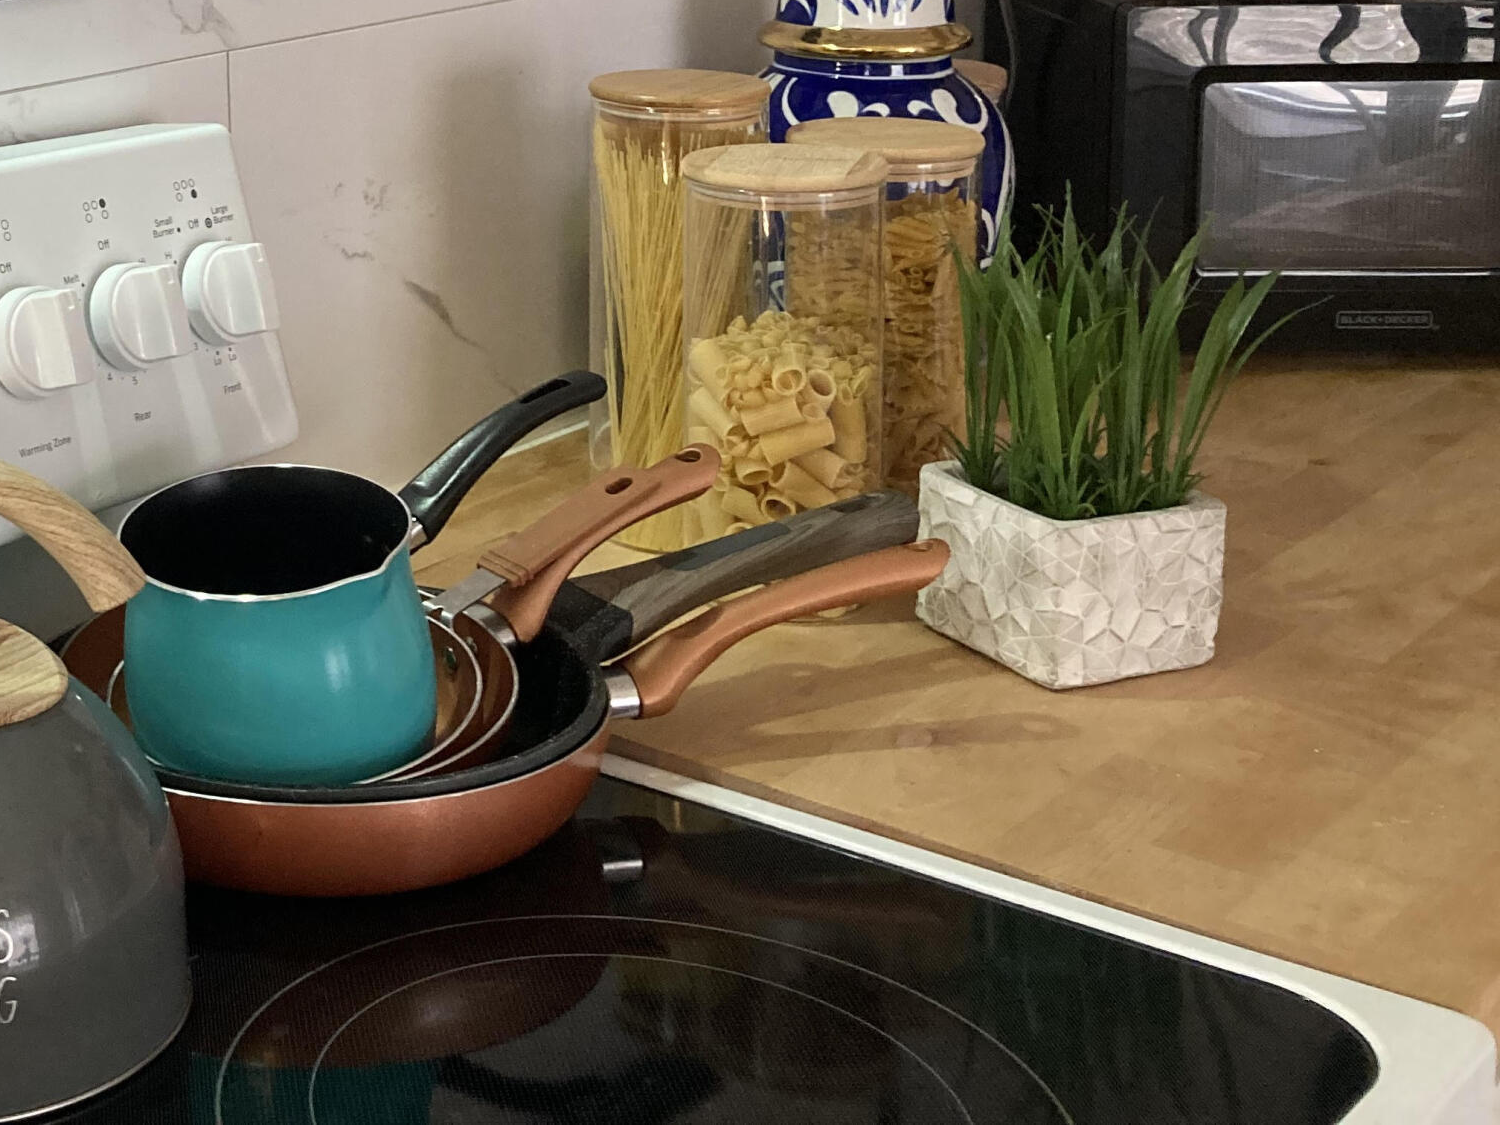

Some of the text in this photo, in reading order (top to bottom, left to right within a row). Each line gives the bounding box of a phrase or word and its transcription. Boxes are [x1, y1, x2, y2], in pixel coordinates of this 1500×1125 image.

[97, 239, 110, 251] Off
[0, 262, 12, 274] Off
[63, 274, 80, 286] Melt
